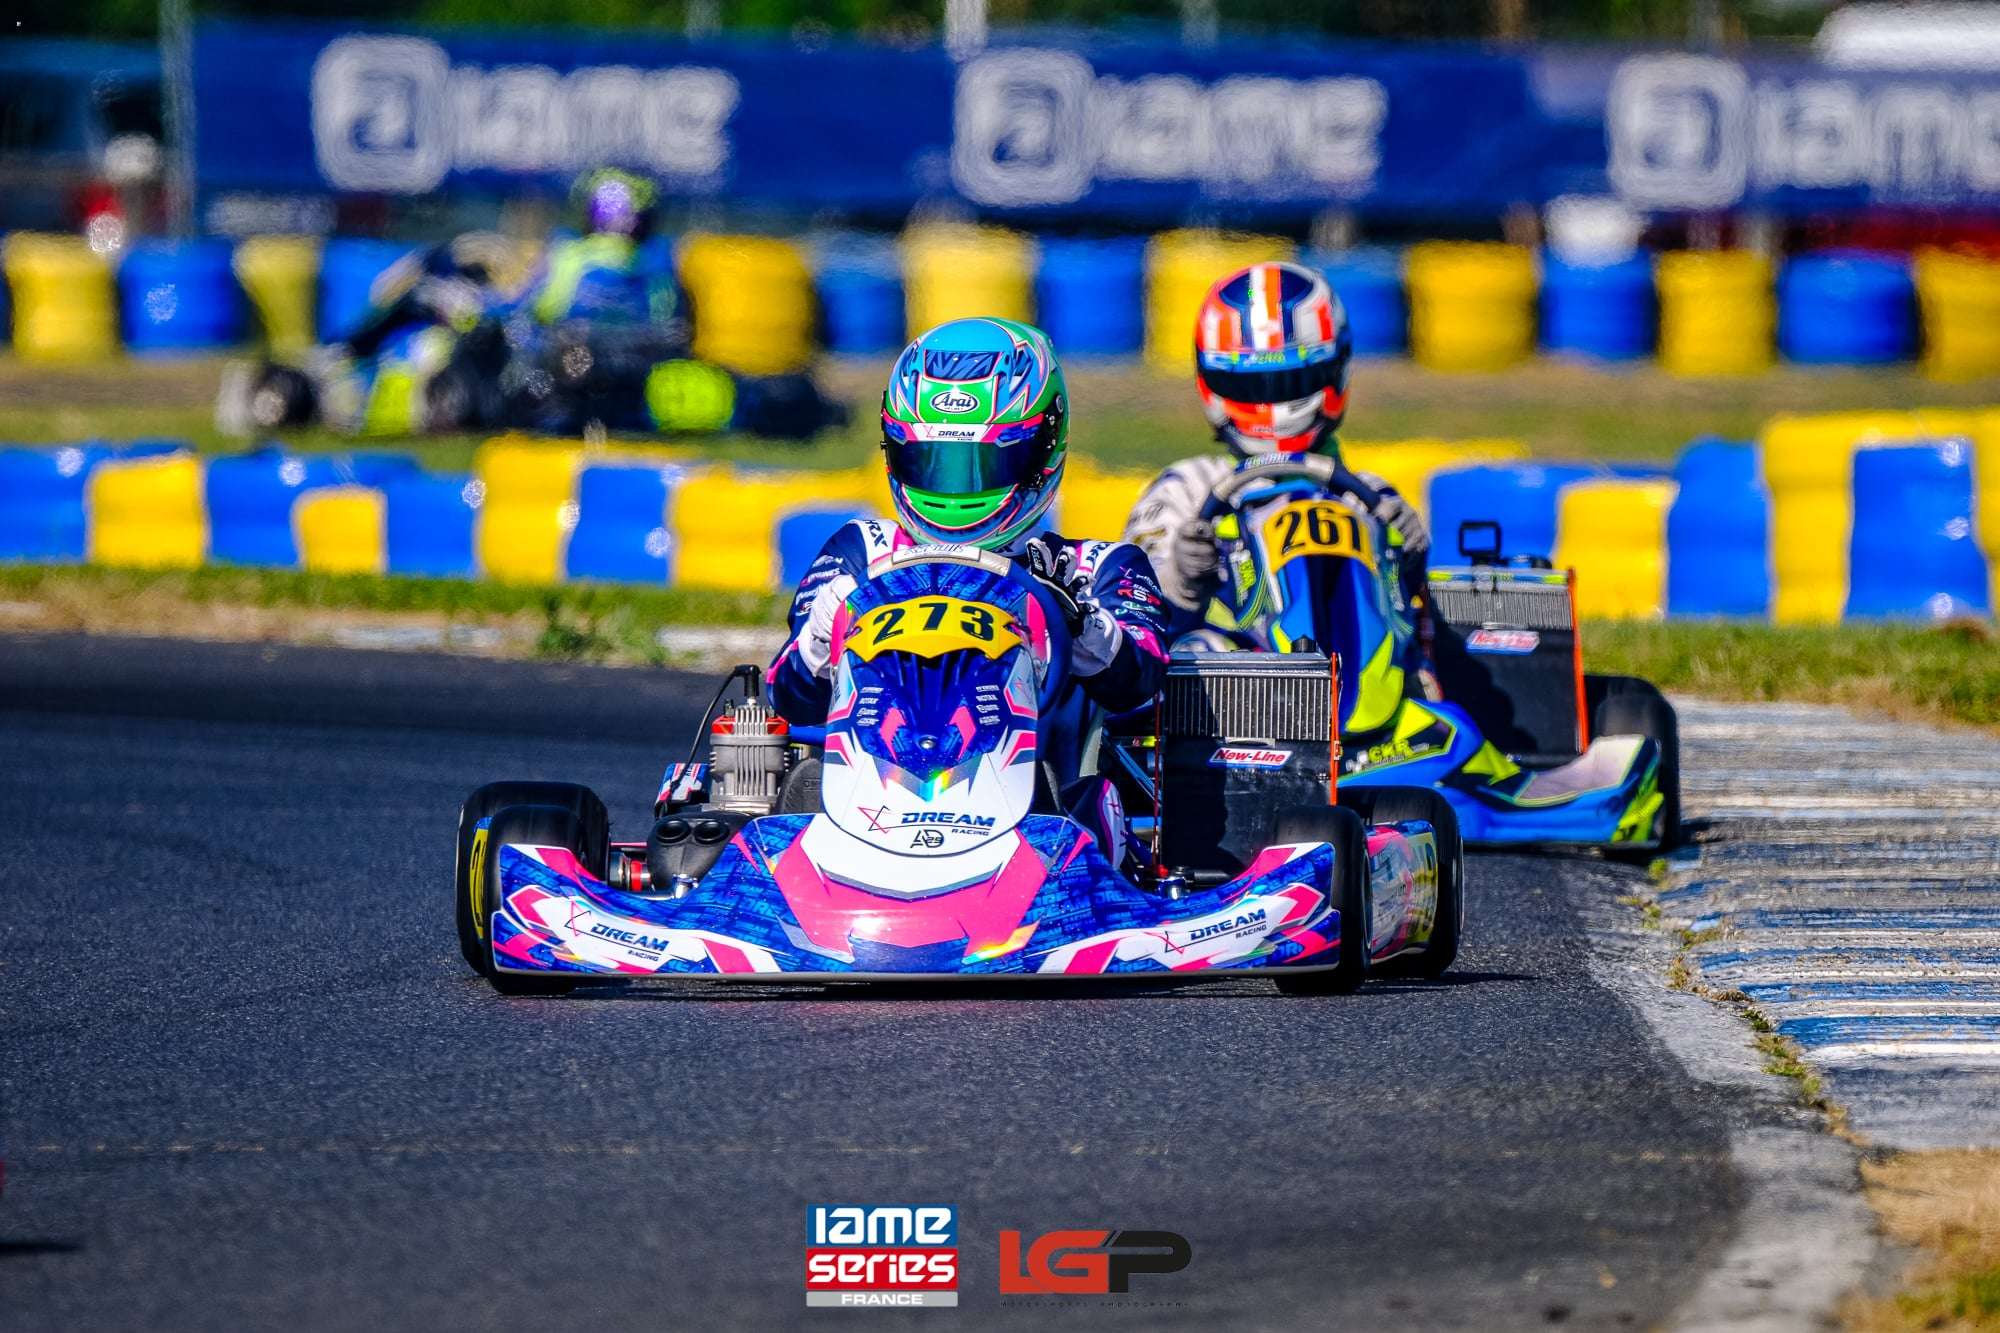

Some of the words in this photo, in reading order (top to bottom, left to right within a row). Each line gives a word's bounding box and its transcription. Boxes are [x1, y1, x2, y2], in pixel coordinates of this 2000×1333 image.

[935, 393, 973, 408] Arai
[1275, 506, 1362, 555] 261
[873, 602, 995, 646] 273
[1214, 749, 1286, 763] New-Line
[901, 812, 996, 828] DREAM
[951, 828, 989, 837] RACING
[1188, 908, 1267, 941] DREAM
[1235, 924, 1267, 939] RACING
[590, 923, 670, 952] DREAM
[627, 949, 660, 962] RACING
